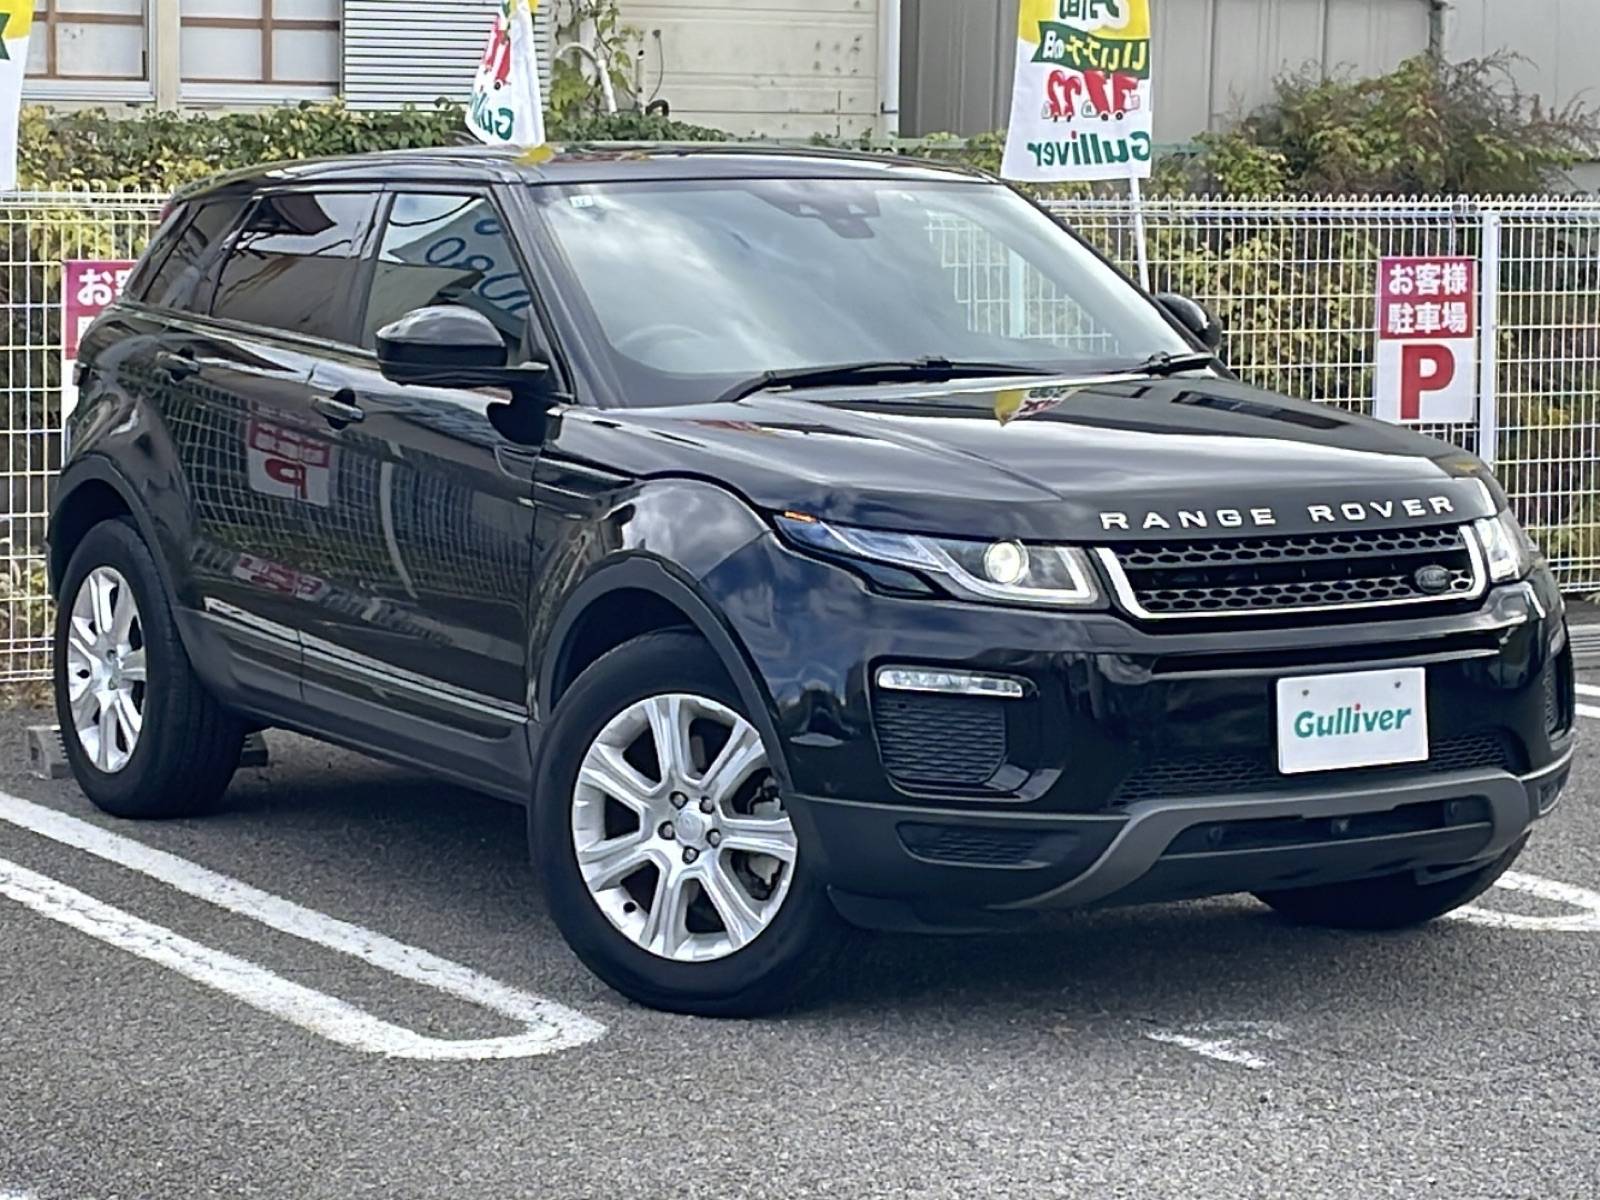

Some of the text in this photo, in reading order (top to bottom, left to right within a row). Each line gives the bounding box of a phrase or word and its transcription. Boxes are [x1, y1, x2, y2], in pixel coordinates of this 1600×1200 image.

[1389, 263, 1467, 296] お客様
[1388, 302, 1467, 335] 駐車場
[1401, 344, 1455, 419] P
[1099, 496, 1454, 530] RANGE ROVER
[1294, 703, 1412, 738] Gulliver
